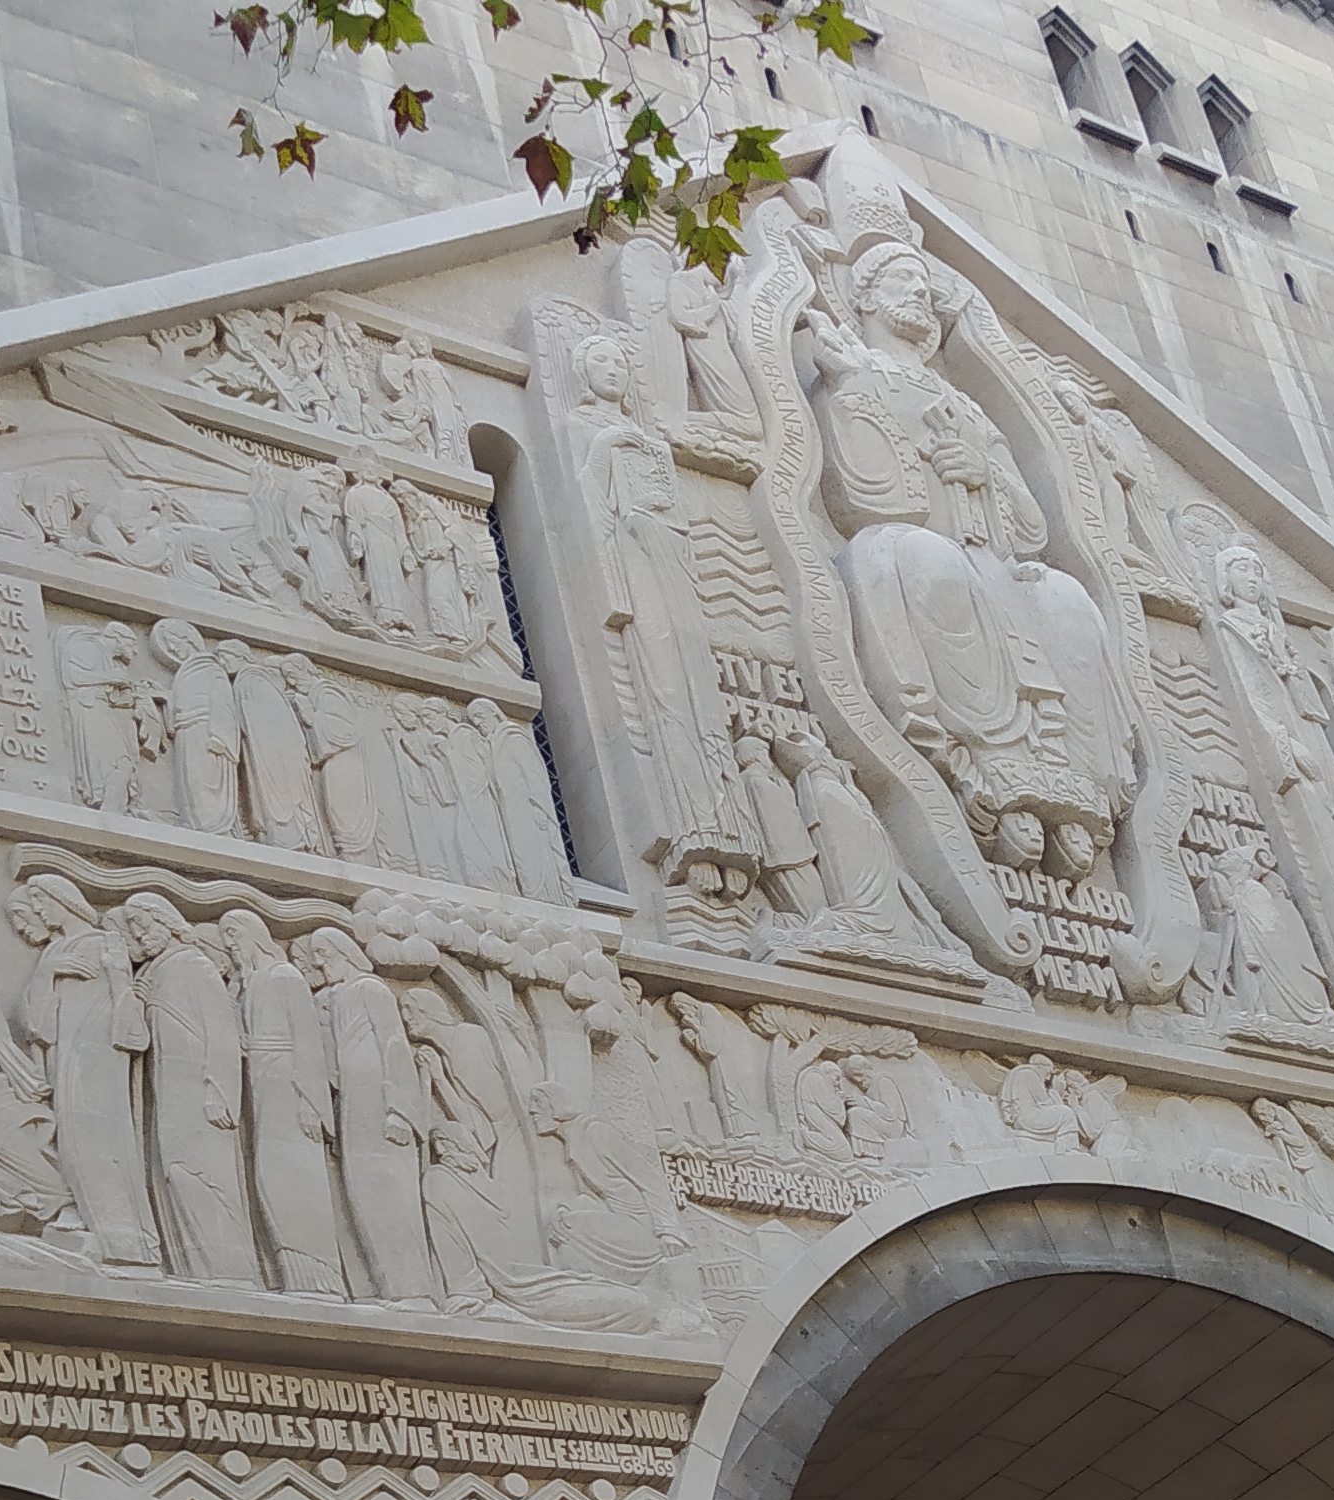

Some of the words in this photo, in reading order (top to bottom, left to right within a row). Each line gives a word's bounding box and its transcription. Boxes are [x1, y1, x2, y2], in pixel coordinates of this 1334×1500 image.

[227, 435, 267, 456] MON
[266, 444, 294, 466] FILS
[1034, 953, 1125, 1002] MEAM
[737, 1183, 781, 1207] DANS
[783, 1190, 813, 1209] LES
[213, 1362, 250, 1405] LUI
[379, 1378, 511, 1427] SEIGNEUR
[554, 1402, 634, 1442] IRIONS
[629, 1408, 689, 1443] NOUS
[49, 1395, 129, 1435] AVEZ
[130, 1400, 186, 1439] LES
[186, 1399, 315, 1450] PAROLES
[315, 1416, 353, 1453] DE
[353, 1422, 394, 1456] LA
[382, 1416, 434, 1458] VIE
[435, 1420, 568, 1471] ETERNELLE
